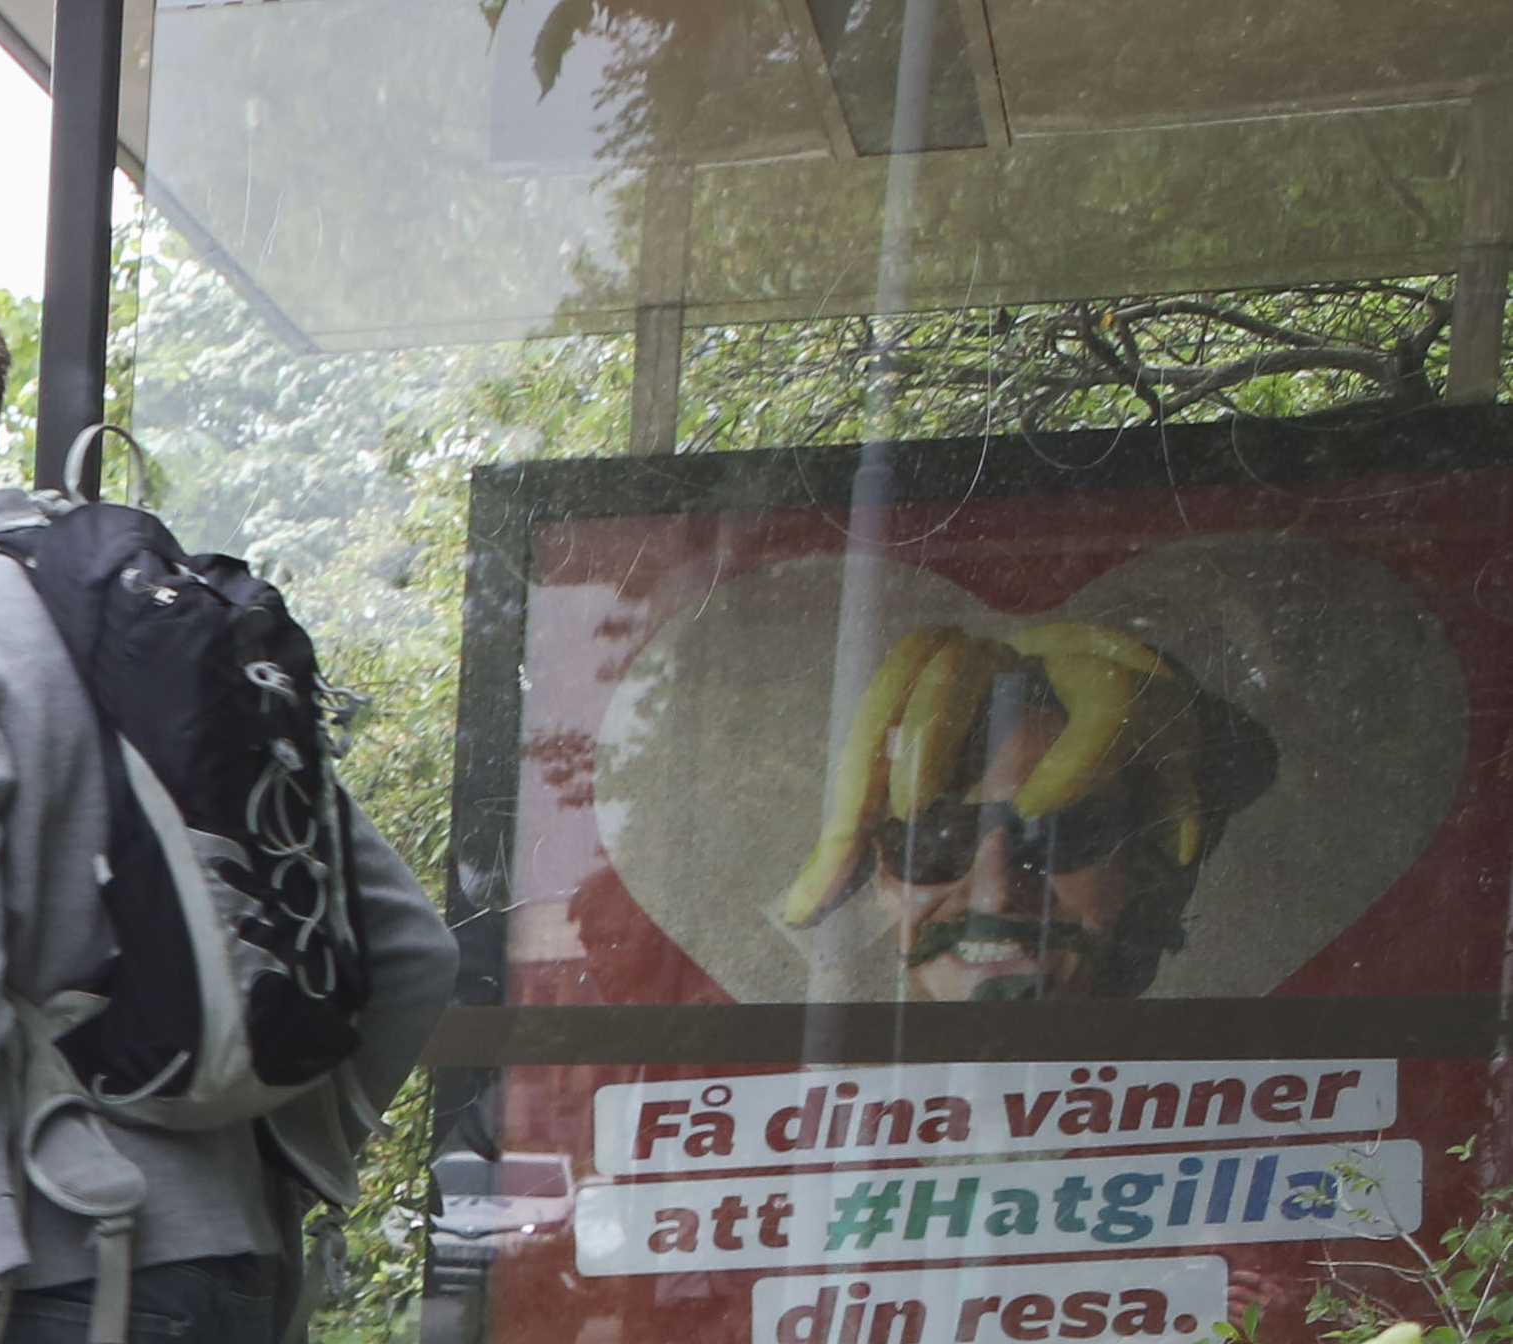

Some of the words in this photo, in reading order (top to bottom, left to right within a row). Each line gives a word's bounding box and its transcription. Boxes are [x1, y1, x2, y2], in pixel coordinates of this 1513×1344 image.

[635, 1083, 735, 1162] Få
[764, 1082, 971, 1152] dina
[1004, 1066, 1361, 1138] vänner
[647, 1192, 794, 1253] att
[824, 1154, 1340, 1252] #Hatgilla
[955, 1285, 1198, 1343] resa.
